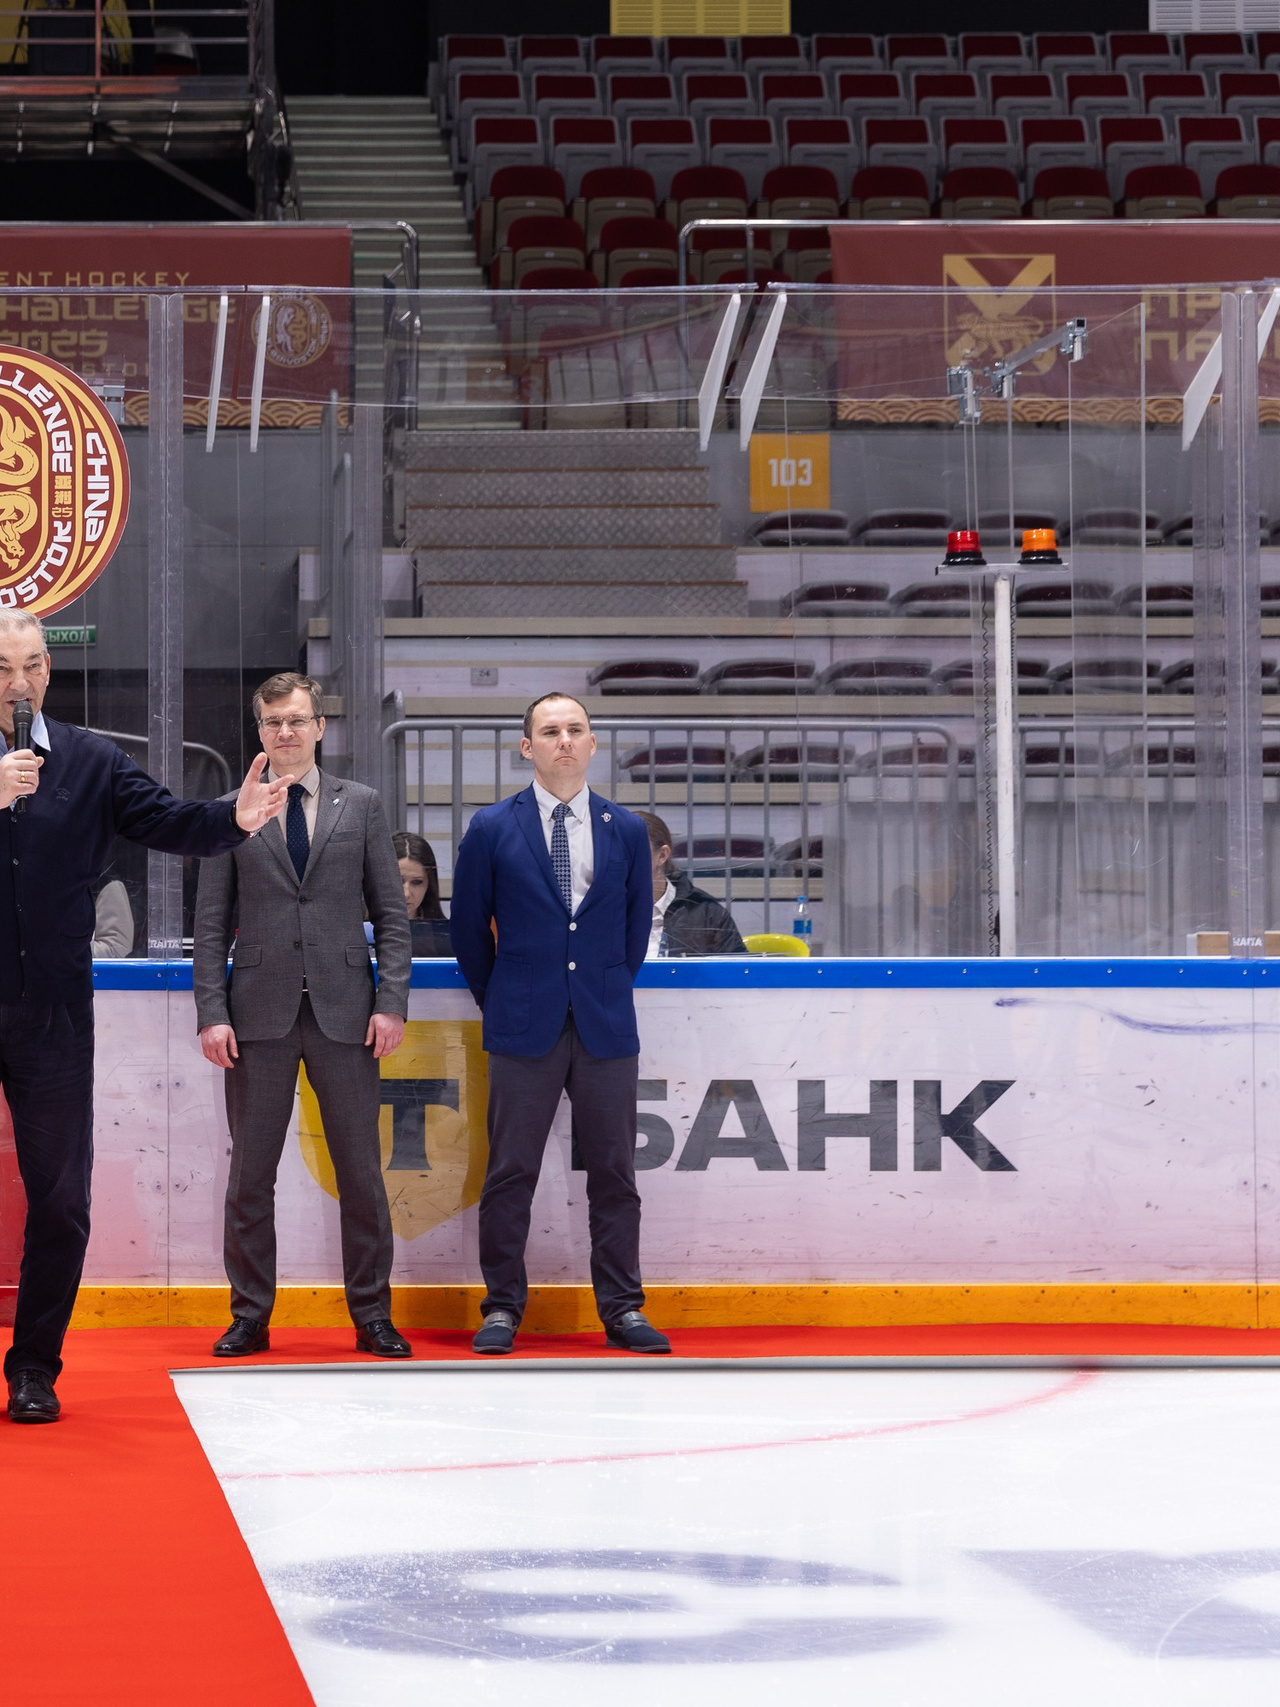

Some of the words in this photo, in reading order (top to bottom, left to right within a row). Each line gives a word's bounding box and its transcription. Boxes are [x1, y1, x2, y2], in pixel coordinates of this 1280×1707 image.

[65, 271, 191, 287] HOCKEY
[768, 458, 812, 487] 103
[84, 432, 109, 542] CHINA
[46, 630, 90, 643] ЫХОД
